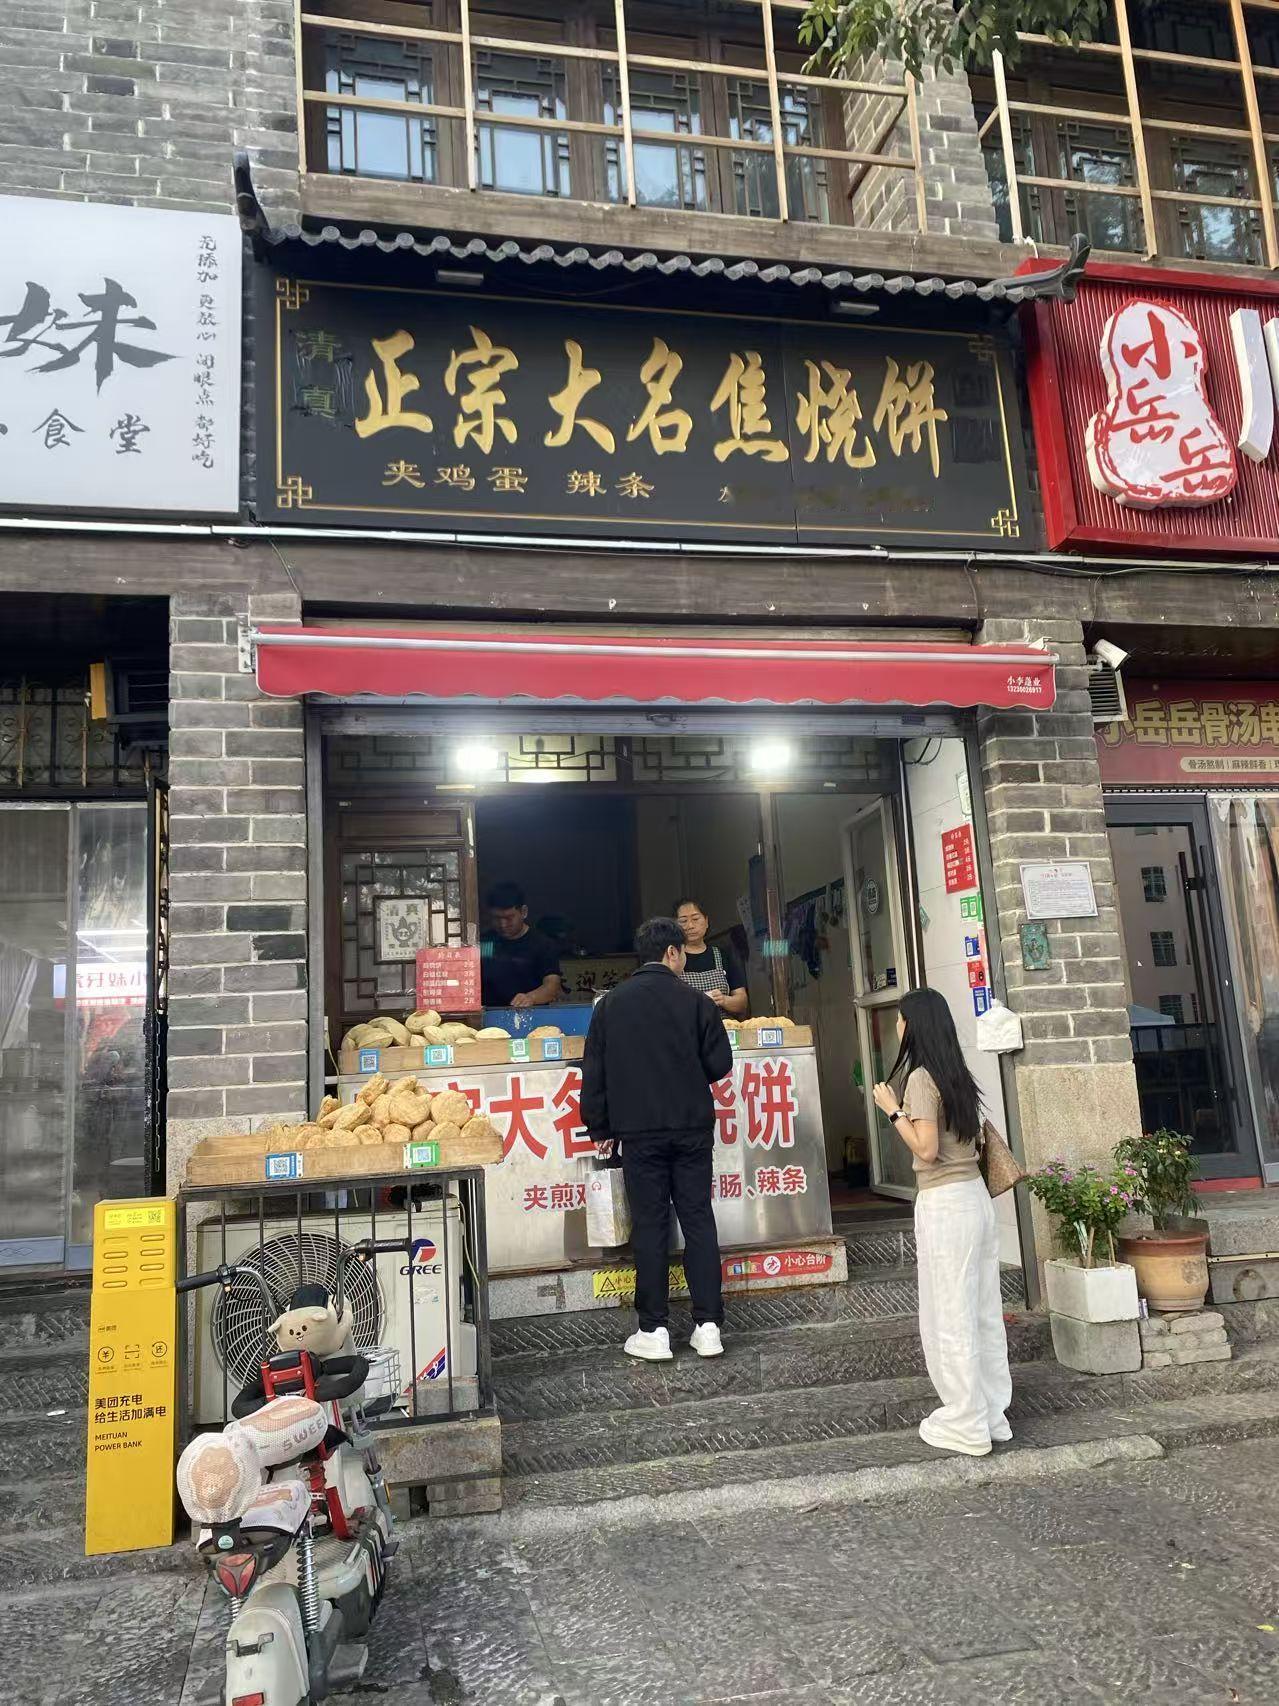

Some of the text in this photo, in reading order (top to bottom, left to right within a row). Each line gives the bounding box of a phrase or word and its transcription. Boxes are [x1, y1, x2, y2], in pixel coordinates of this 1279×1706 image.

[354, 324, 949, 479] 正宗大名焦烧饼
[0, 407, 151, 454] 食堂
[381, 459, 656, 499] 夹鸡蛋 辣条
[784, 1254, 827, 1268] 小心台阶
[399, 1264, 442, 1276] GREE
[95, 1394, 143, 1410] 美团充电
[94, 1406, 167, 1424] 给生活加满电
[95, 1432, 128, 1441] MEITUAN
[95, 1440, 143, 1452] POWER BANK
